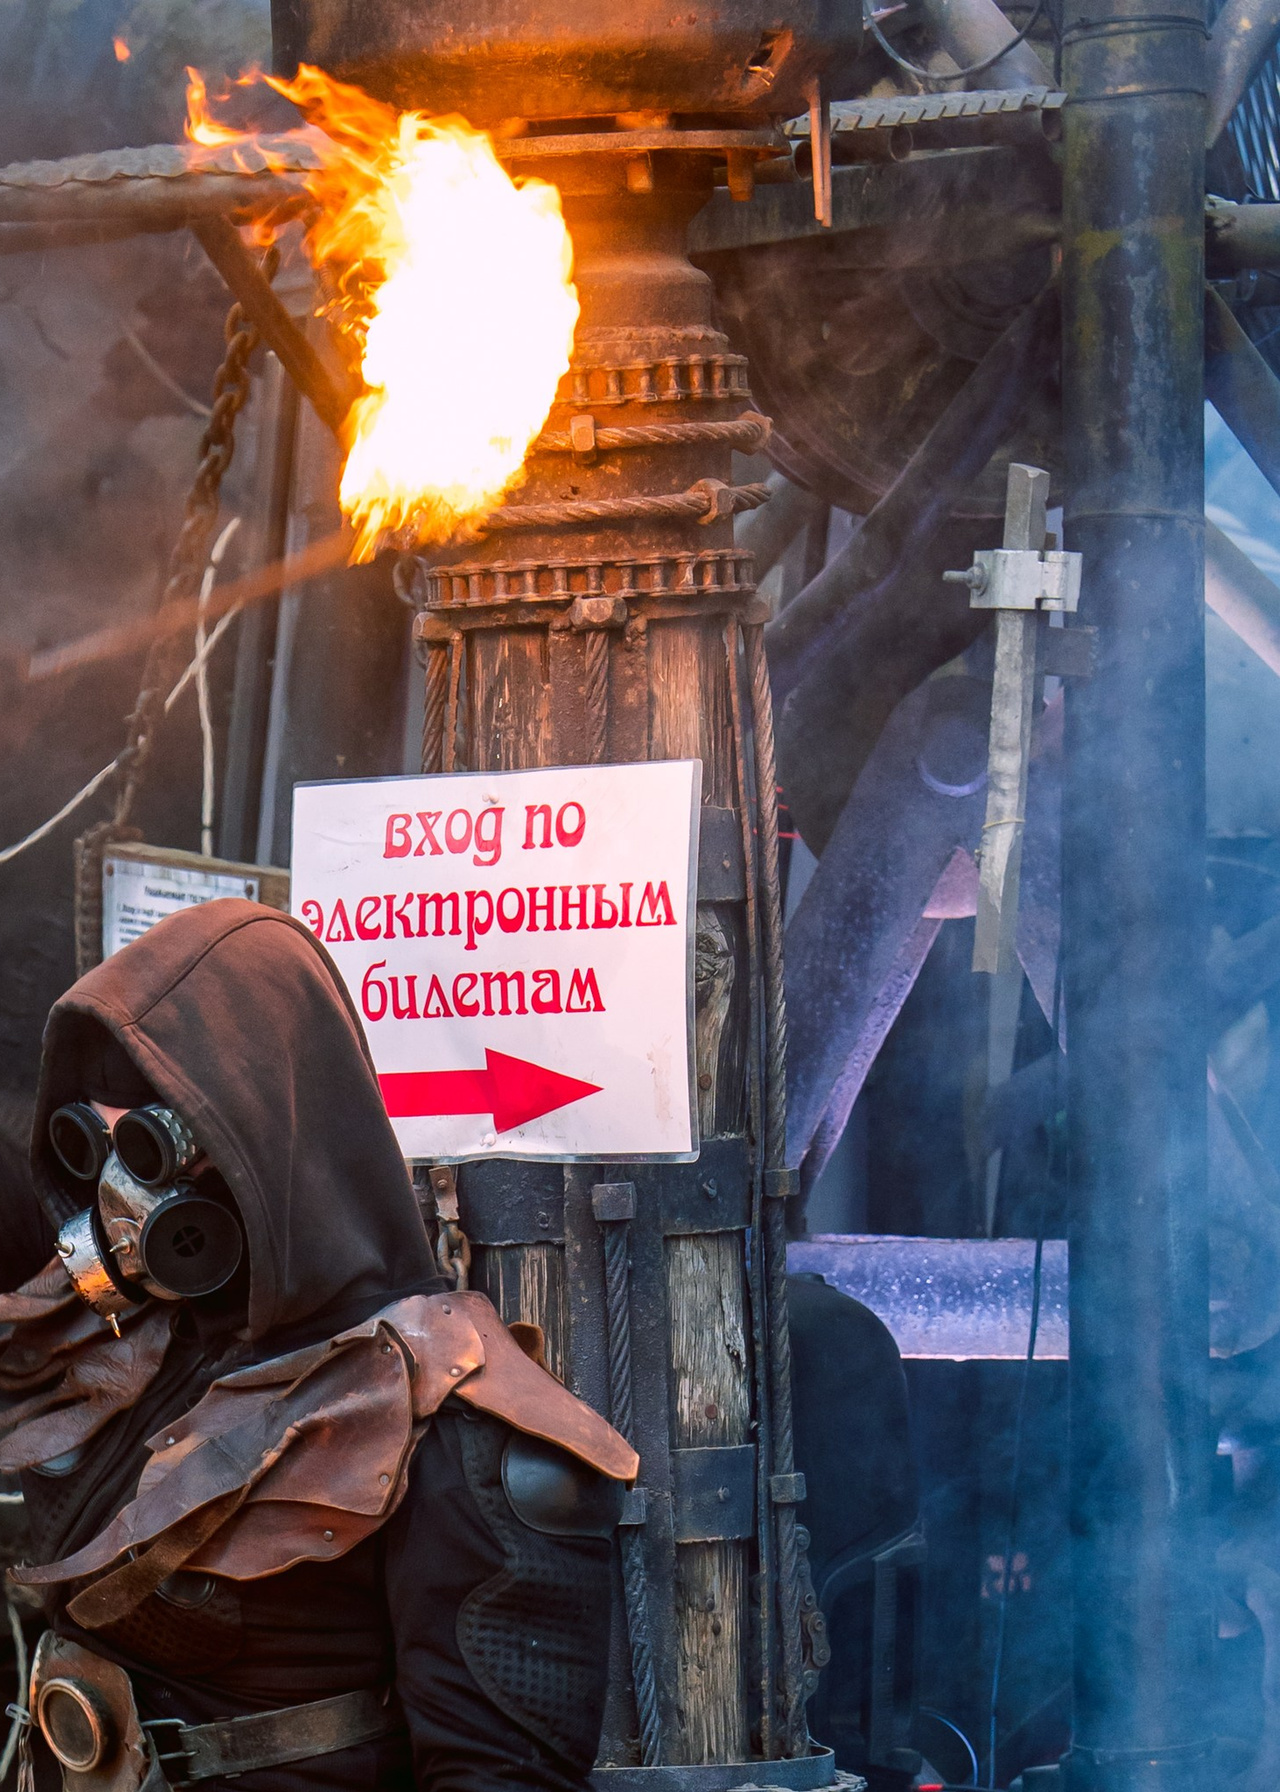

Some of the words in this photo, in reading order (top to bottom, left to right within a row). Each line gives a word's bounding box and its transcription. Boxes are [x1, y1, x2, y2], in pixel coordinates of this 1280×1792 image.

[382, 806, 506, 867] вход
[521, 801, 587, 851] по
[301, 880, 678, 952] электронным
[360, 959, 607, 1023] билетам
